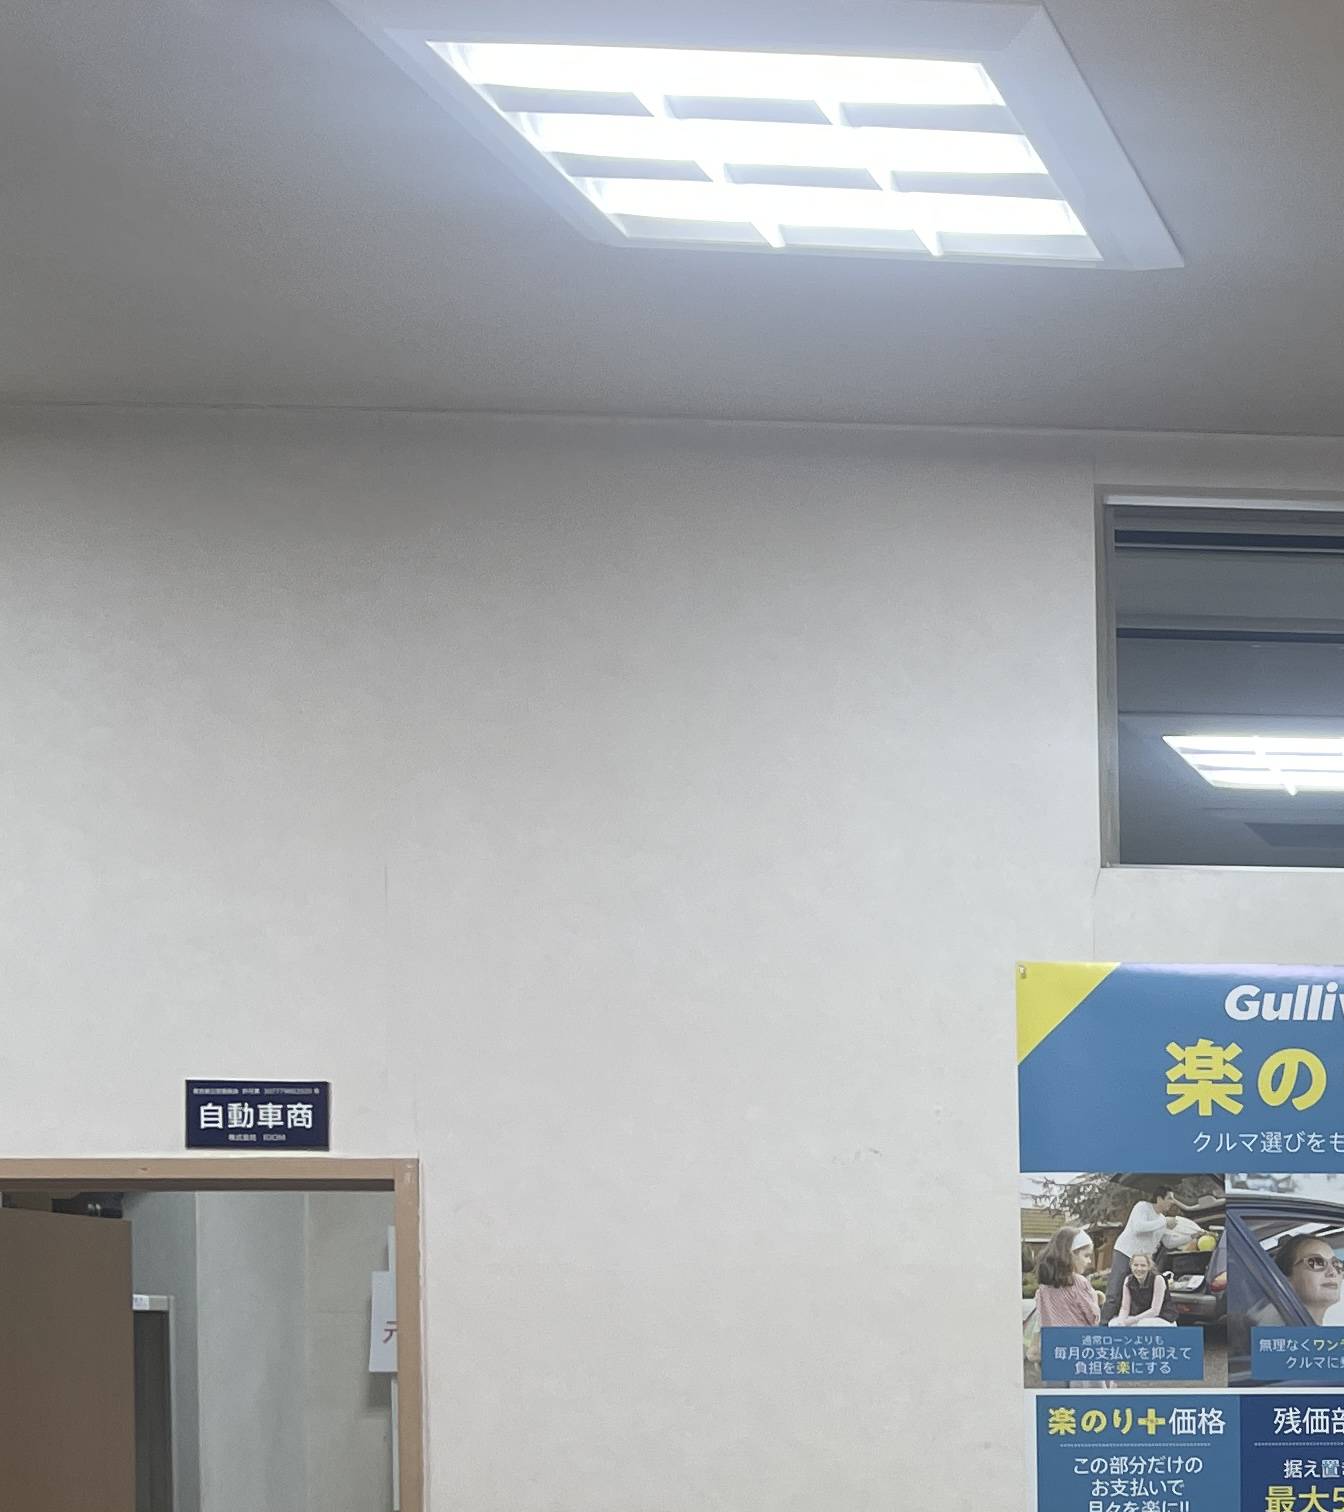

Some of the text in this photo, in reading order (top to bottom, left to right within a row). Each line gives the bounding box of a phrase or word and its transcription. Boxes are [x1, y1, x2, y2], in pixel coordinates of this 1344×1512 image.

[200, 1102, 313, 1129] 自動車商
[1082, 1335, 1165, 1346] 通常ローンよりも
[1054, 1346, 1192, 1360] 毎月の支払いを抑えて
[1074, 1360, 1172, 1375] 負担を楽にする
[1073, 1456, 1203, 1475] この部分だけの
[1091, 1478, 1185, 1497] お支払いで
